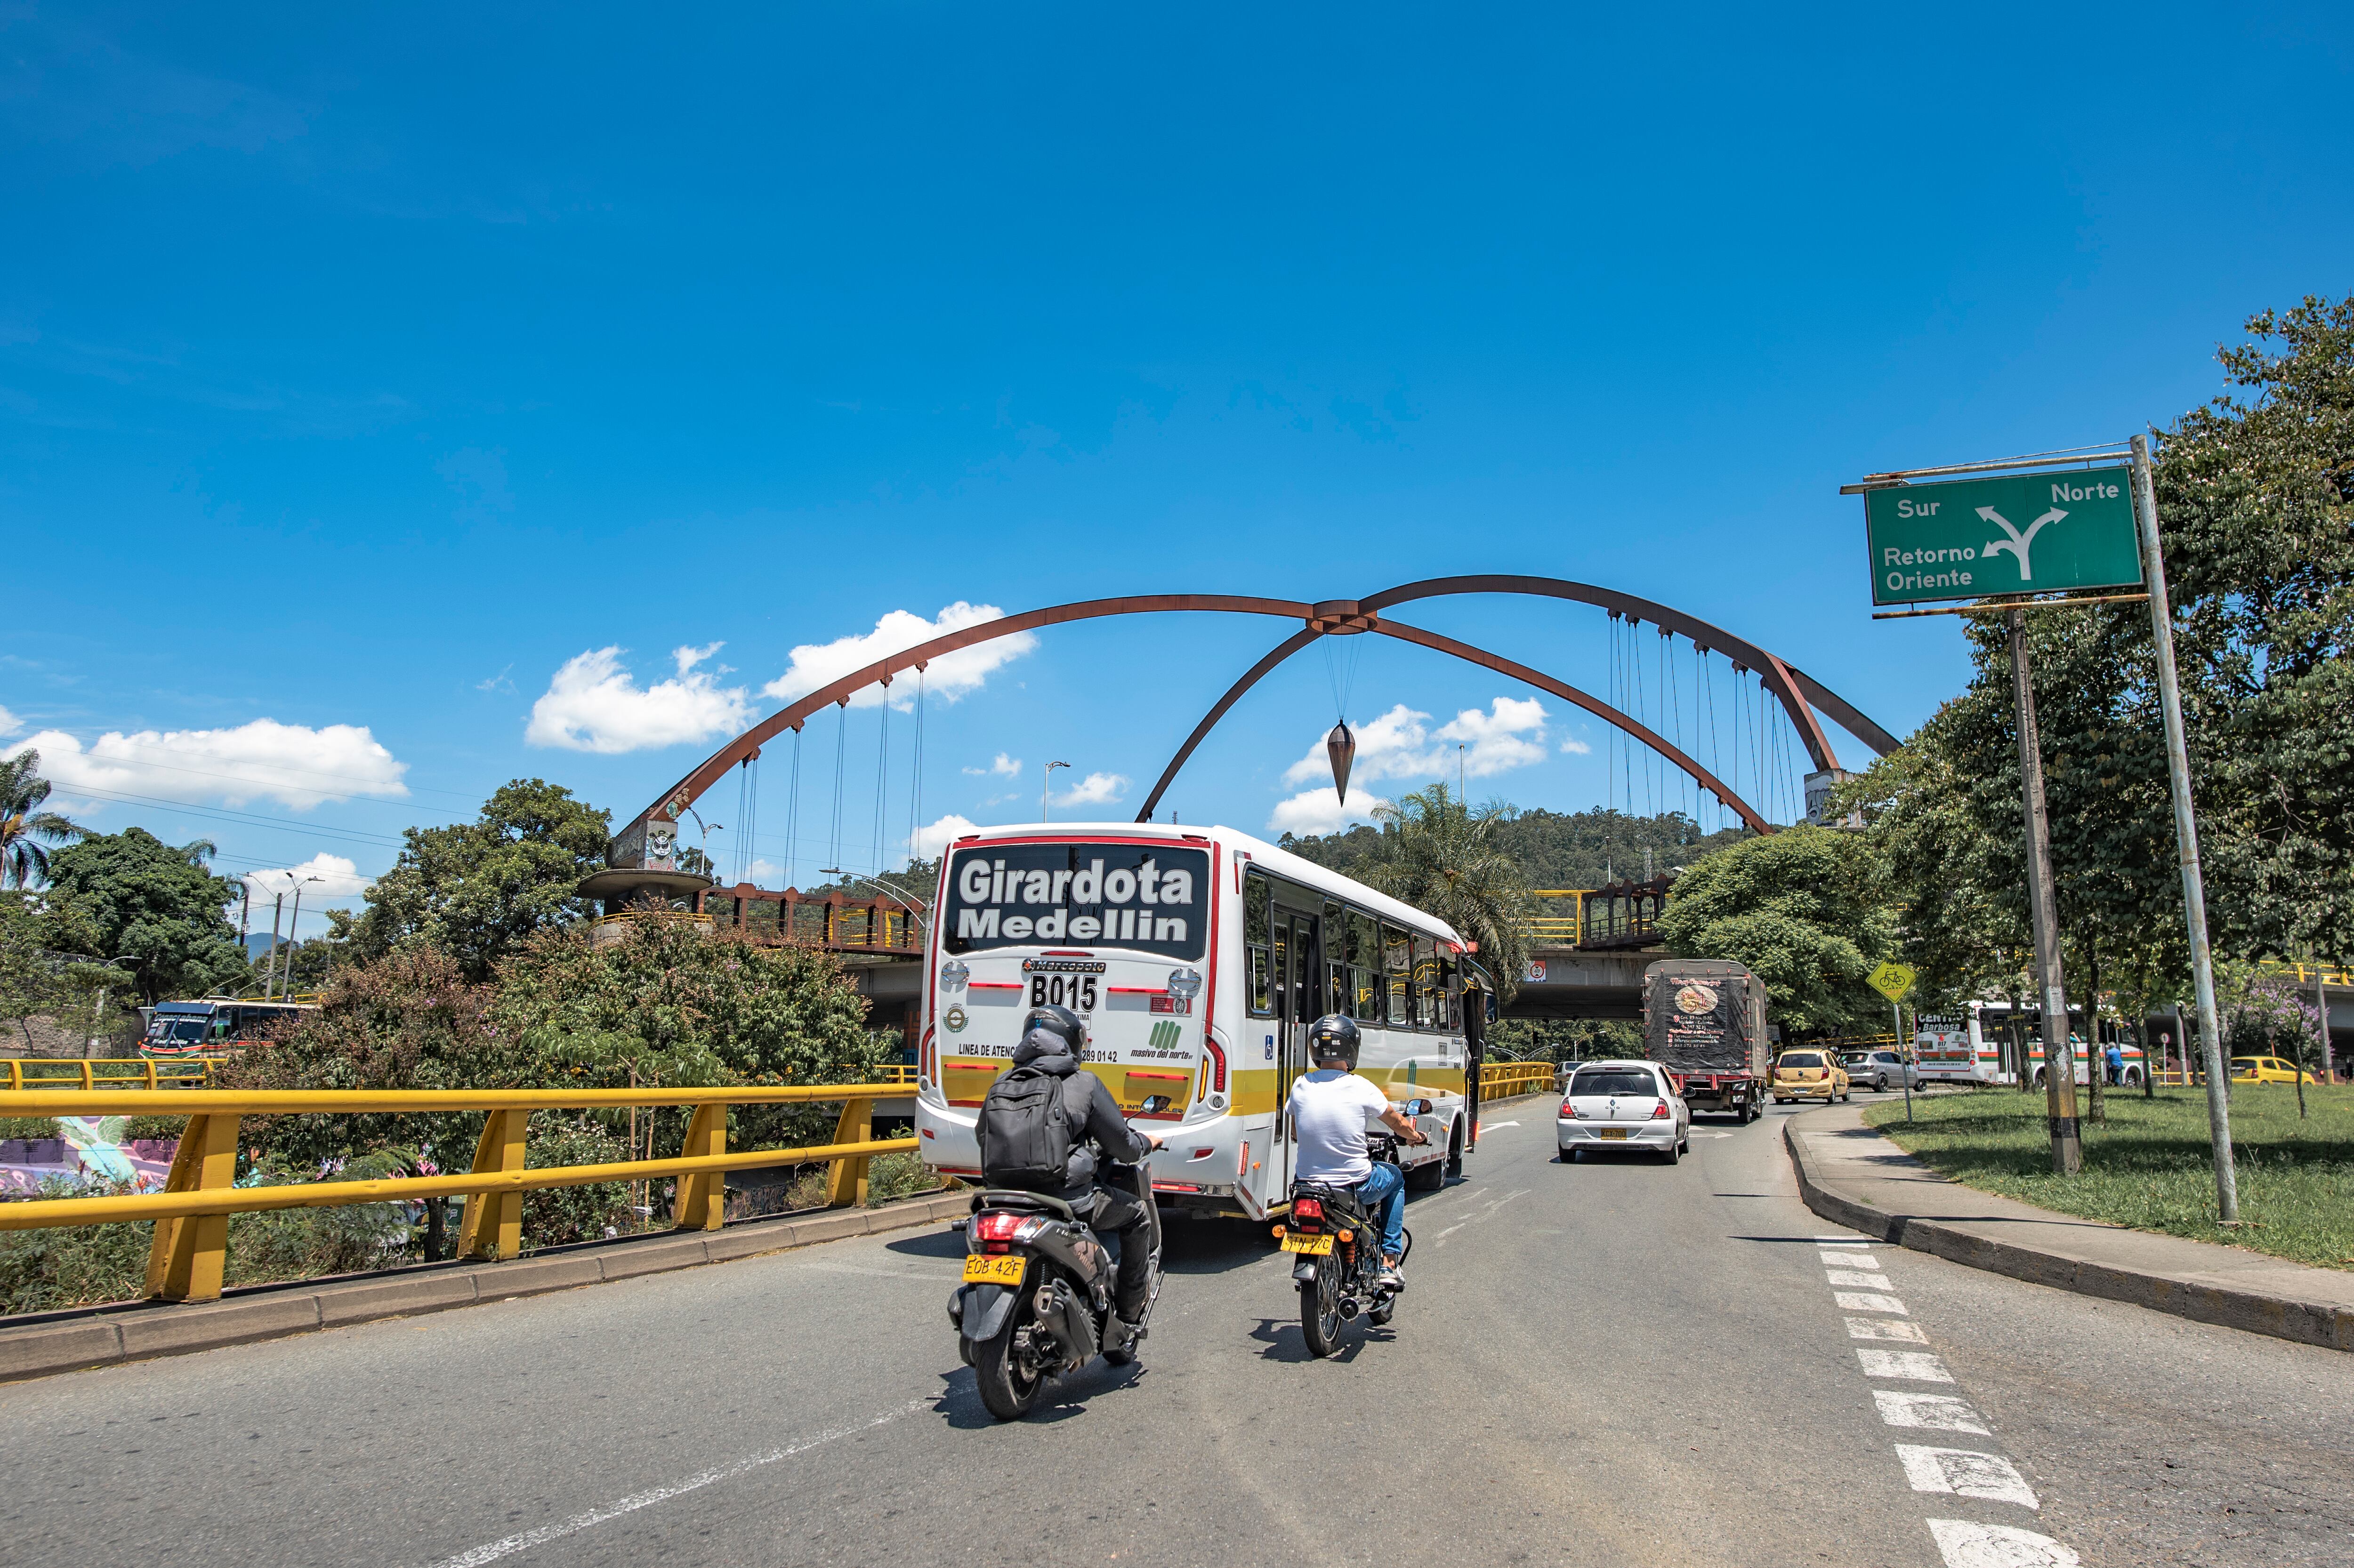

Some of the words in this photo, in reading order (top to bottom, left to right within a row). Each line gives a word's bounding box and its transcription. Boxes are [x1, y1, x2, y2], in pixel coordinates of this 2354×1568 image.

[2051, 482, 2119, 503] Norte
[1897, 499, 1940, 518] Sur
[1884, 546, 1975, 566] Retorno
[1886, 570, 1972, 591] Oriente
[959, 859, 1193, 904] Girardota
[957, 909, 1187, 941] Medellin
[1037, 961, 1104, 972] Marcopolo
[1030, 973, 1097, 1012] B015
[1923, 1023, 1960, 1031] Barbosa
[959, 1044, 979, 1055] LINEA
[981, 1045, 990, 1056] DE
[992, 1045, 1016, 1057] ATENC
[1130, 1049, 1155, 1058] masivo
[1157, 1050, 1168, 1059] del
[1169, 1051, 1189, 1060] norte
[996, 1261, 1021, 1276] 42F
